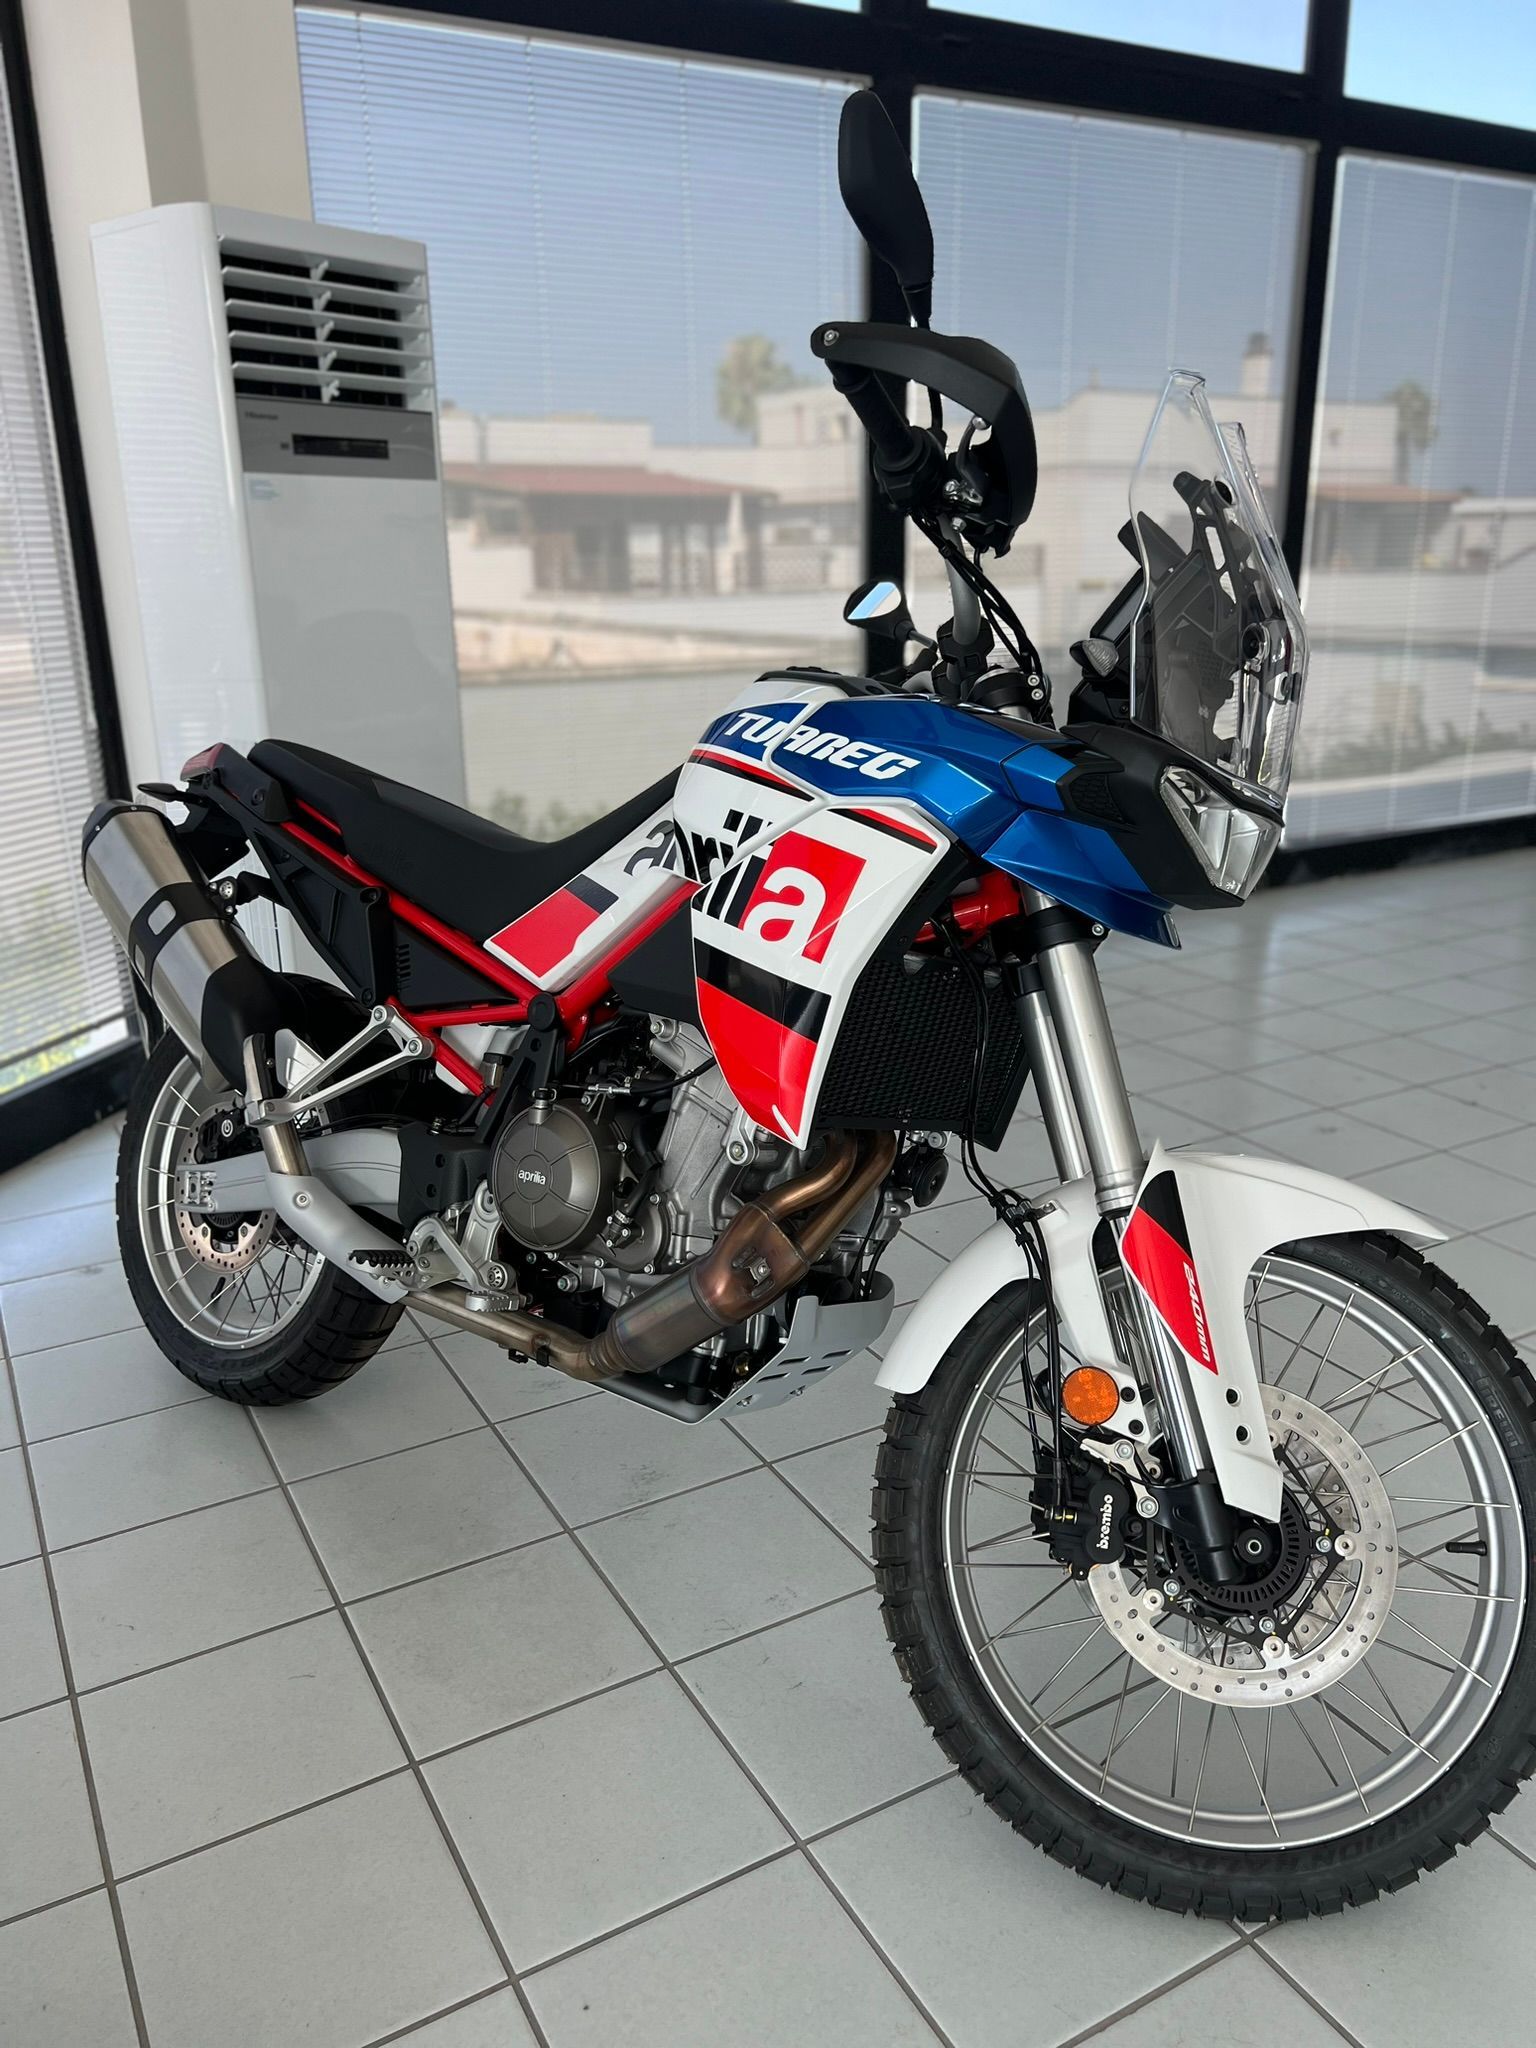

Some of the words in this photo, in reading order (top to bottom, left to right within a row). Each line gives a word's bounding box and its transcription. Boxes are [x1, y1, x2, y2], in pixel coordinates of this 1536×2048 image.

[724, 711, 921, 779] TUAREG
[518, 1169, 546, 1185] aprilia
[1096, 1494, 1114, 1549] brembo
